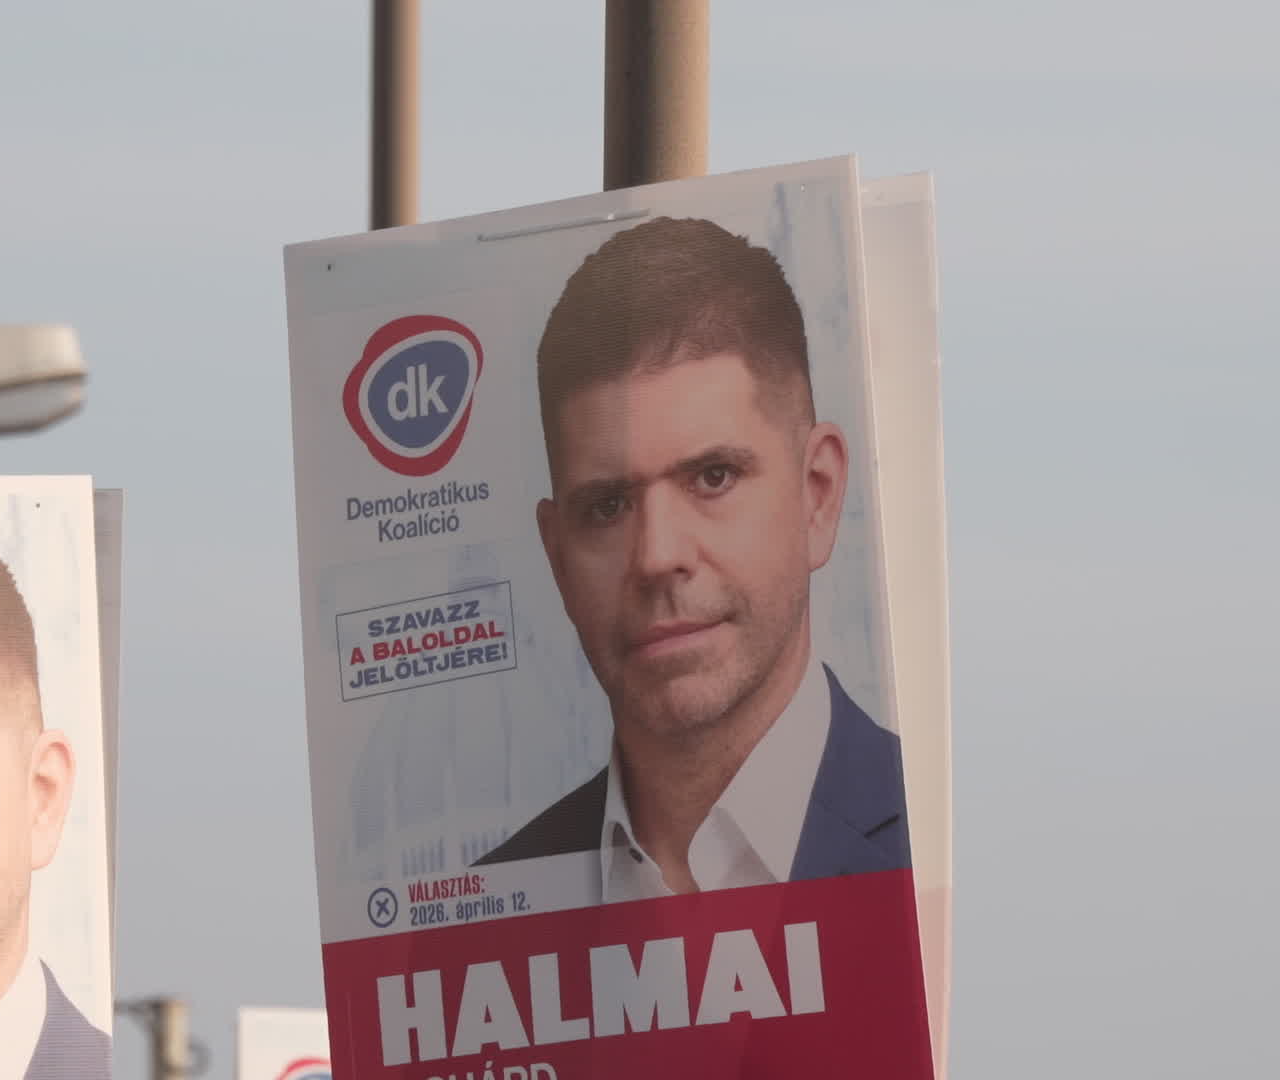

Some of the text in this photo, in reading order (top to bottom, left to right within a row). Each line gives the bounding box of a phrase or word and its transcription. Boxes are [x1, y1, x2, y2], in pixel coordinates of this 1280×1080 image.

[387, 363, 449, 422] dk
[345, 480, 490, 521] Demokratikus
[377, 508, 461, 543] Koalíció
[367, 600, 481, 638] SZAVAZZ
[349, 620, 506, 666] A BALOLDAL
[349, 641, 509, 689] JELÖLTJÉRE!
[407, 871, 486, 904] VÁLASZTÁS:
[409, 890, 532, 927] 2026. április 12.
[375, 920, 826, 1068] HALMAI
